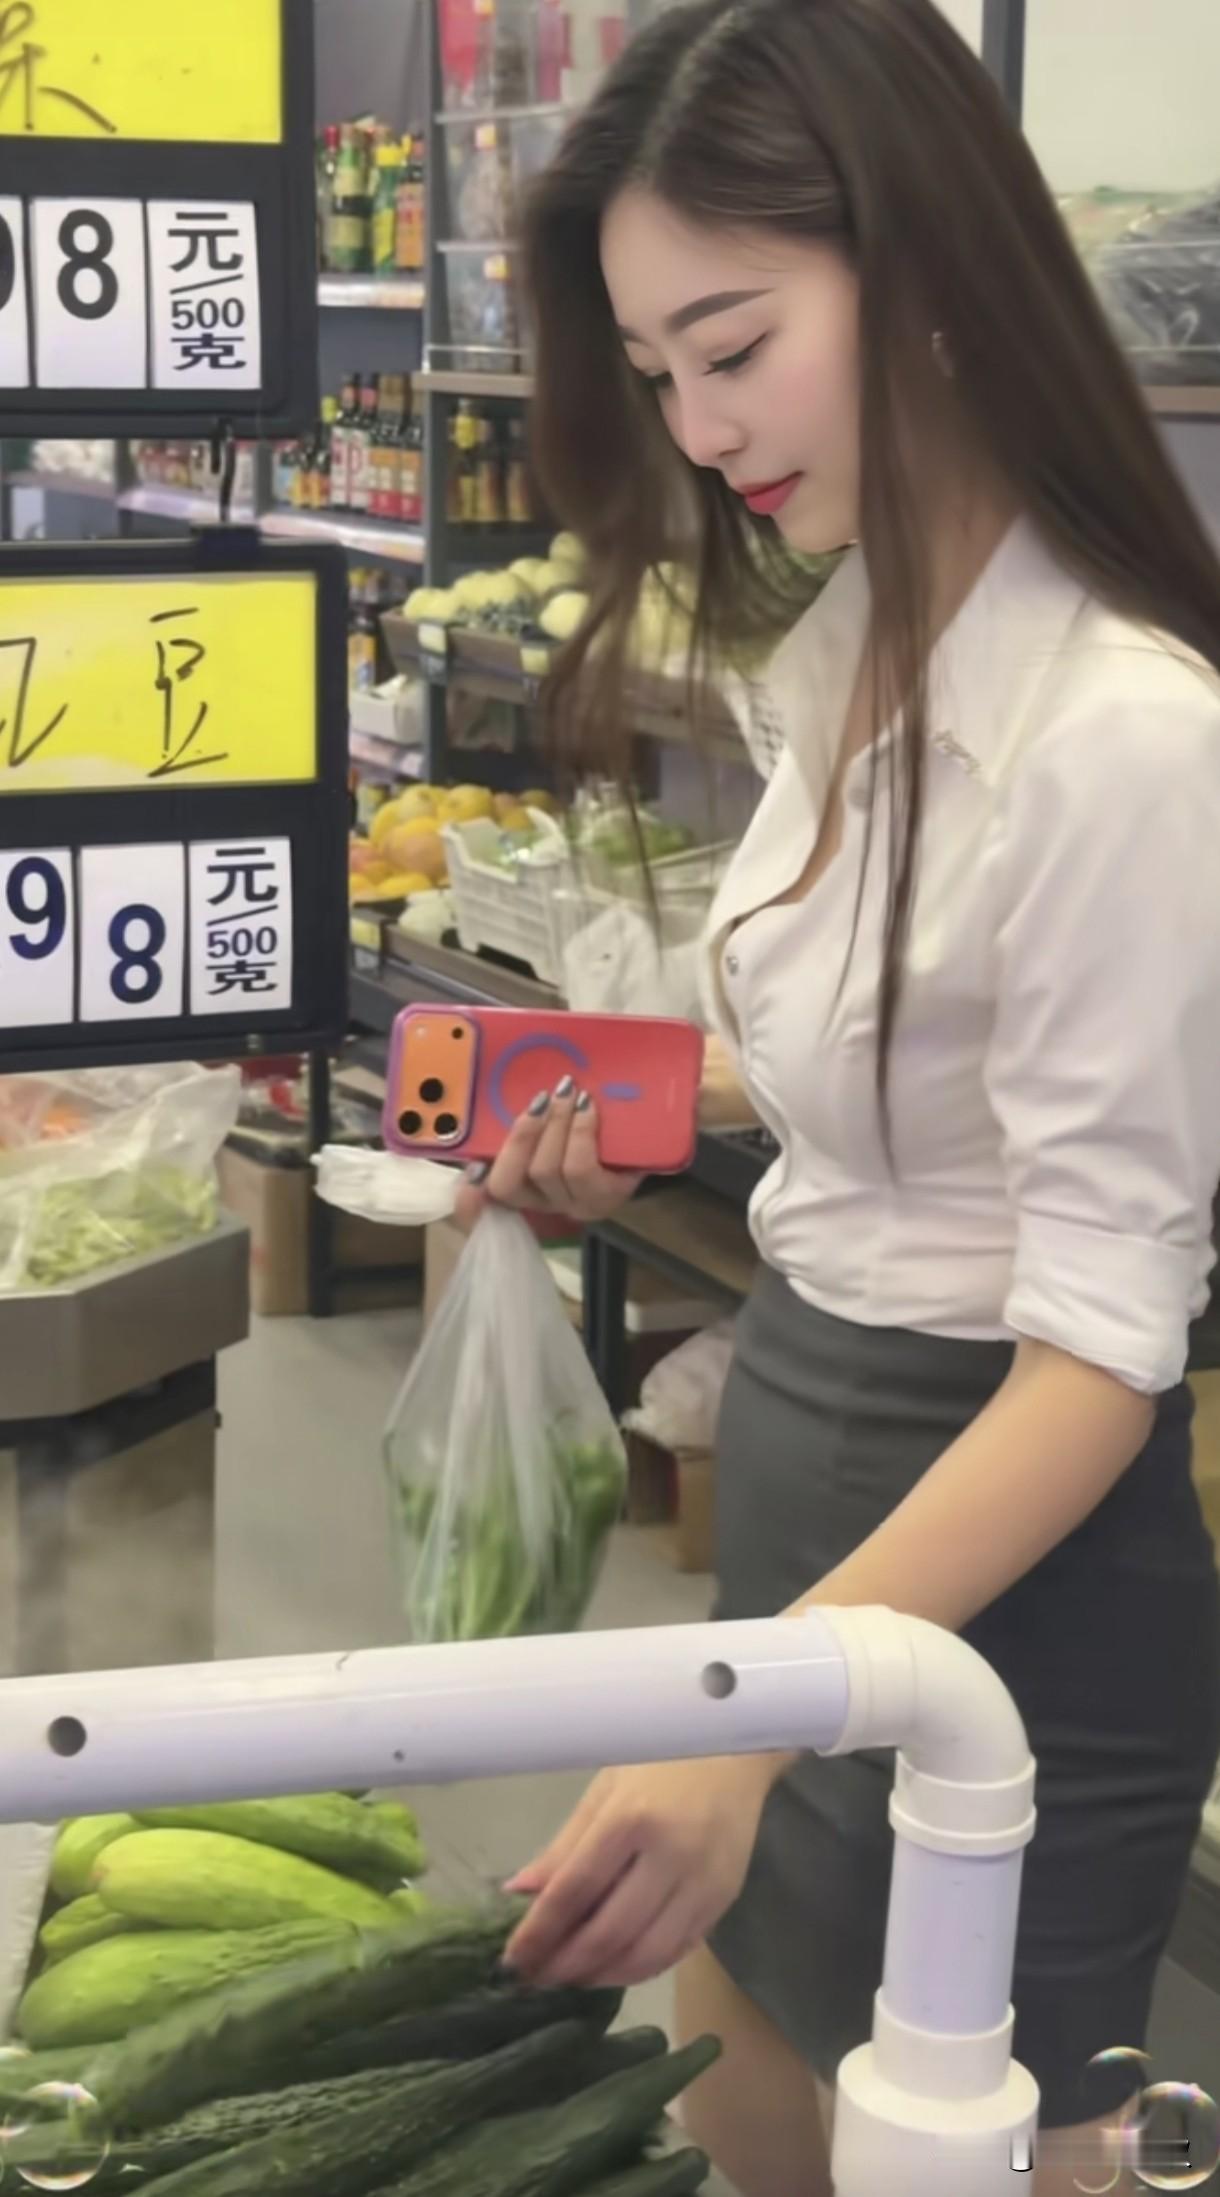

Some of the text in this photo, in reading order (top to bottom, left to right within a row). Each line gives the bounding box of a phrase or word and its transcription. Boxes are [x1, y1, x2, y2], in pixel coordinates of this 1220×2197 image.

[168, 212, 243, 272] 元
[171, 298, 245, 331] 500
[171, 333, 247, 371] 克
[206, 847, 279, 906] 元
[206, 925, 278, 959] 500
[206, 960, 278, 995] 克
